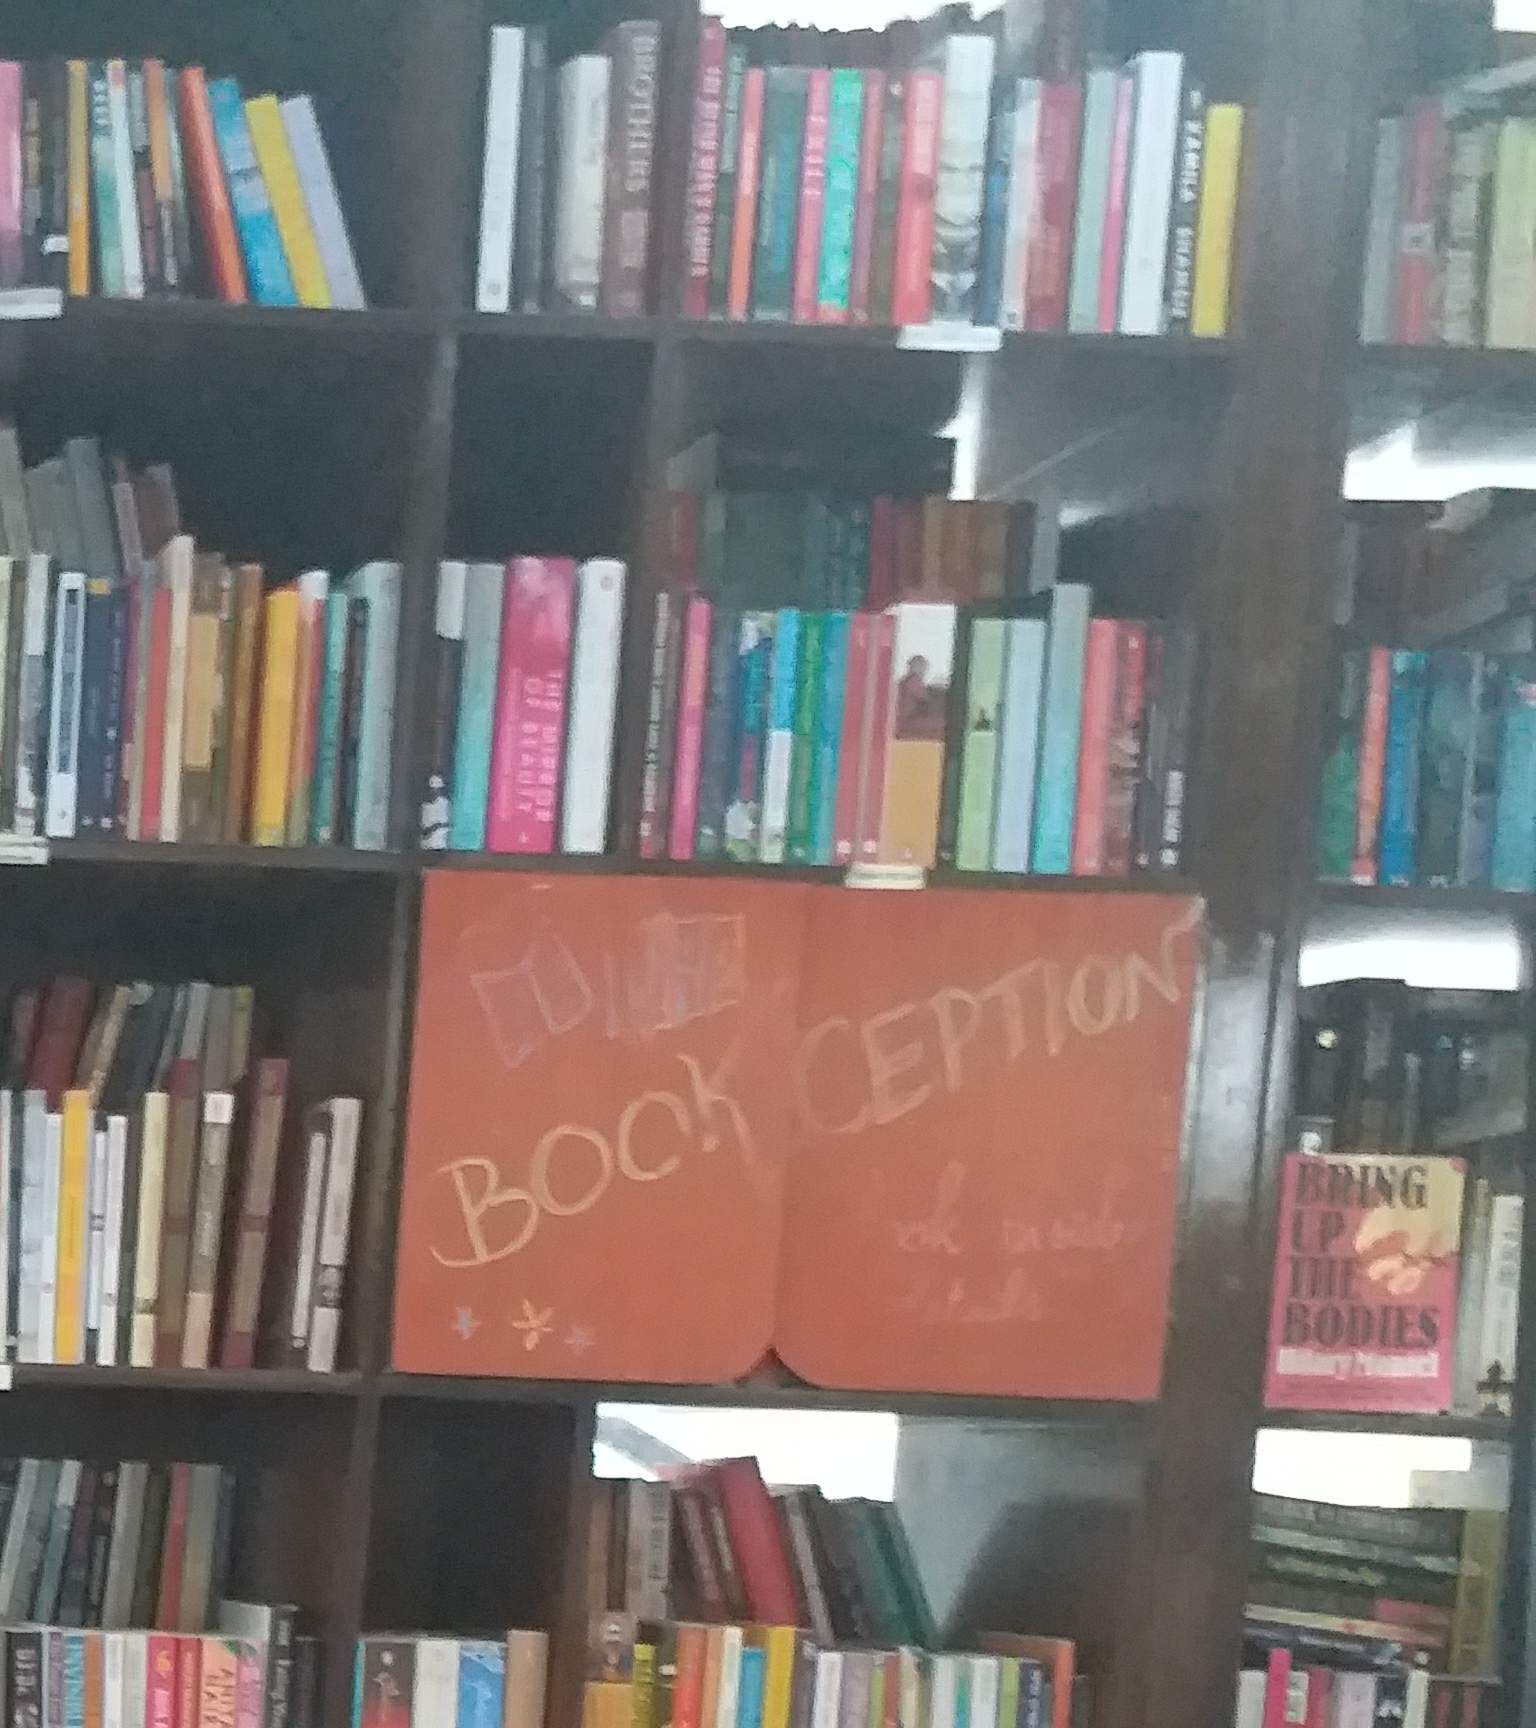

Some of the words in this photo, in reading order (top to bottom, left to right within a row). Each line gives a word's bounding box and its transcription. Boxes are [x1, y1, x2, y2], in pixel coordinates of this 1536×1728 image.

[792, 897, 1206, 1136] CEPTION
[1294, 1160, 1428, 1211] BRING
[1289, 1207, 1349, 1259] UP
[1283, 1303, 1440, 1349] BODIES
